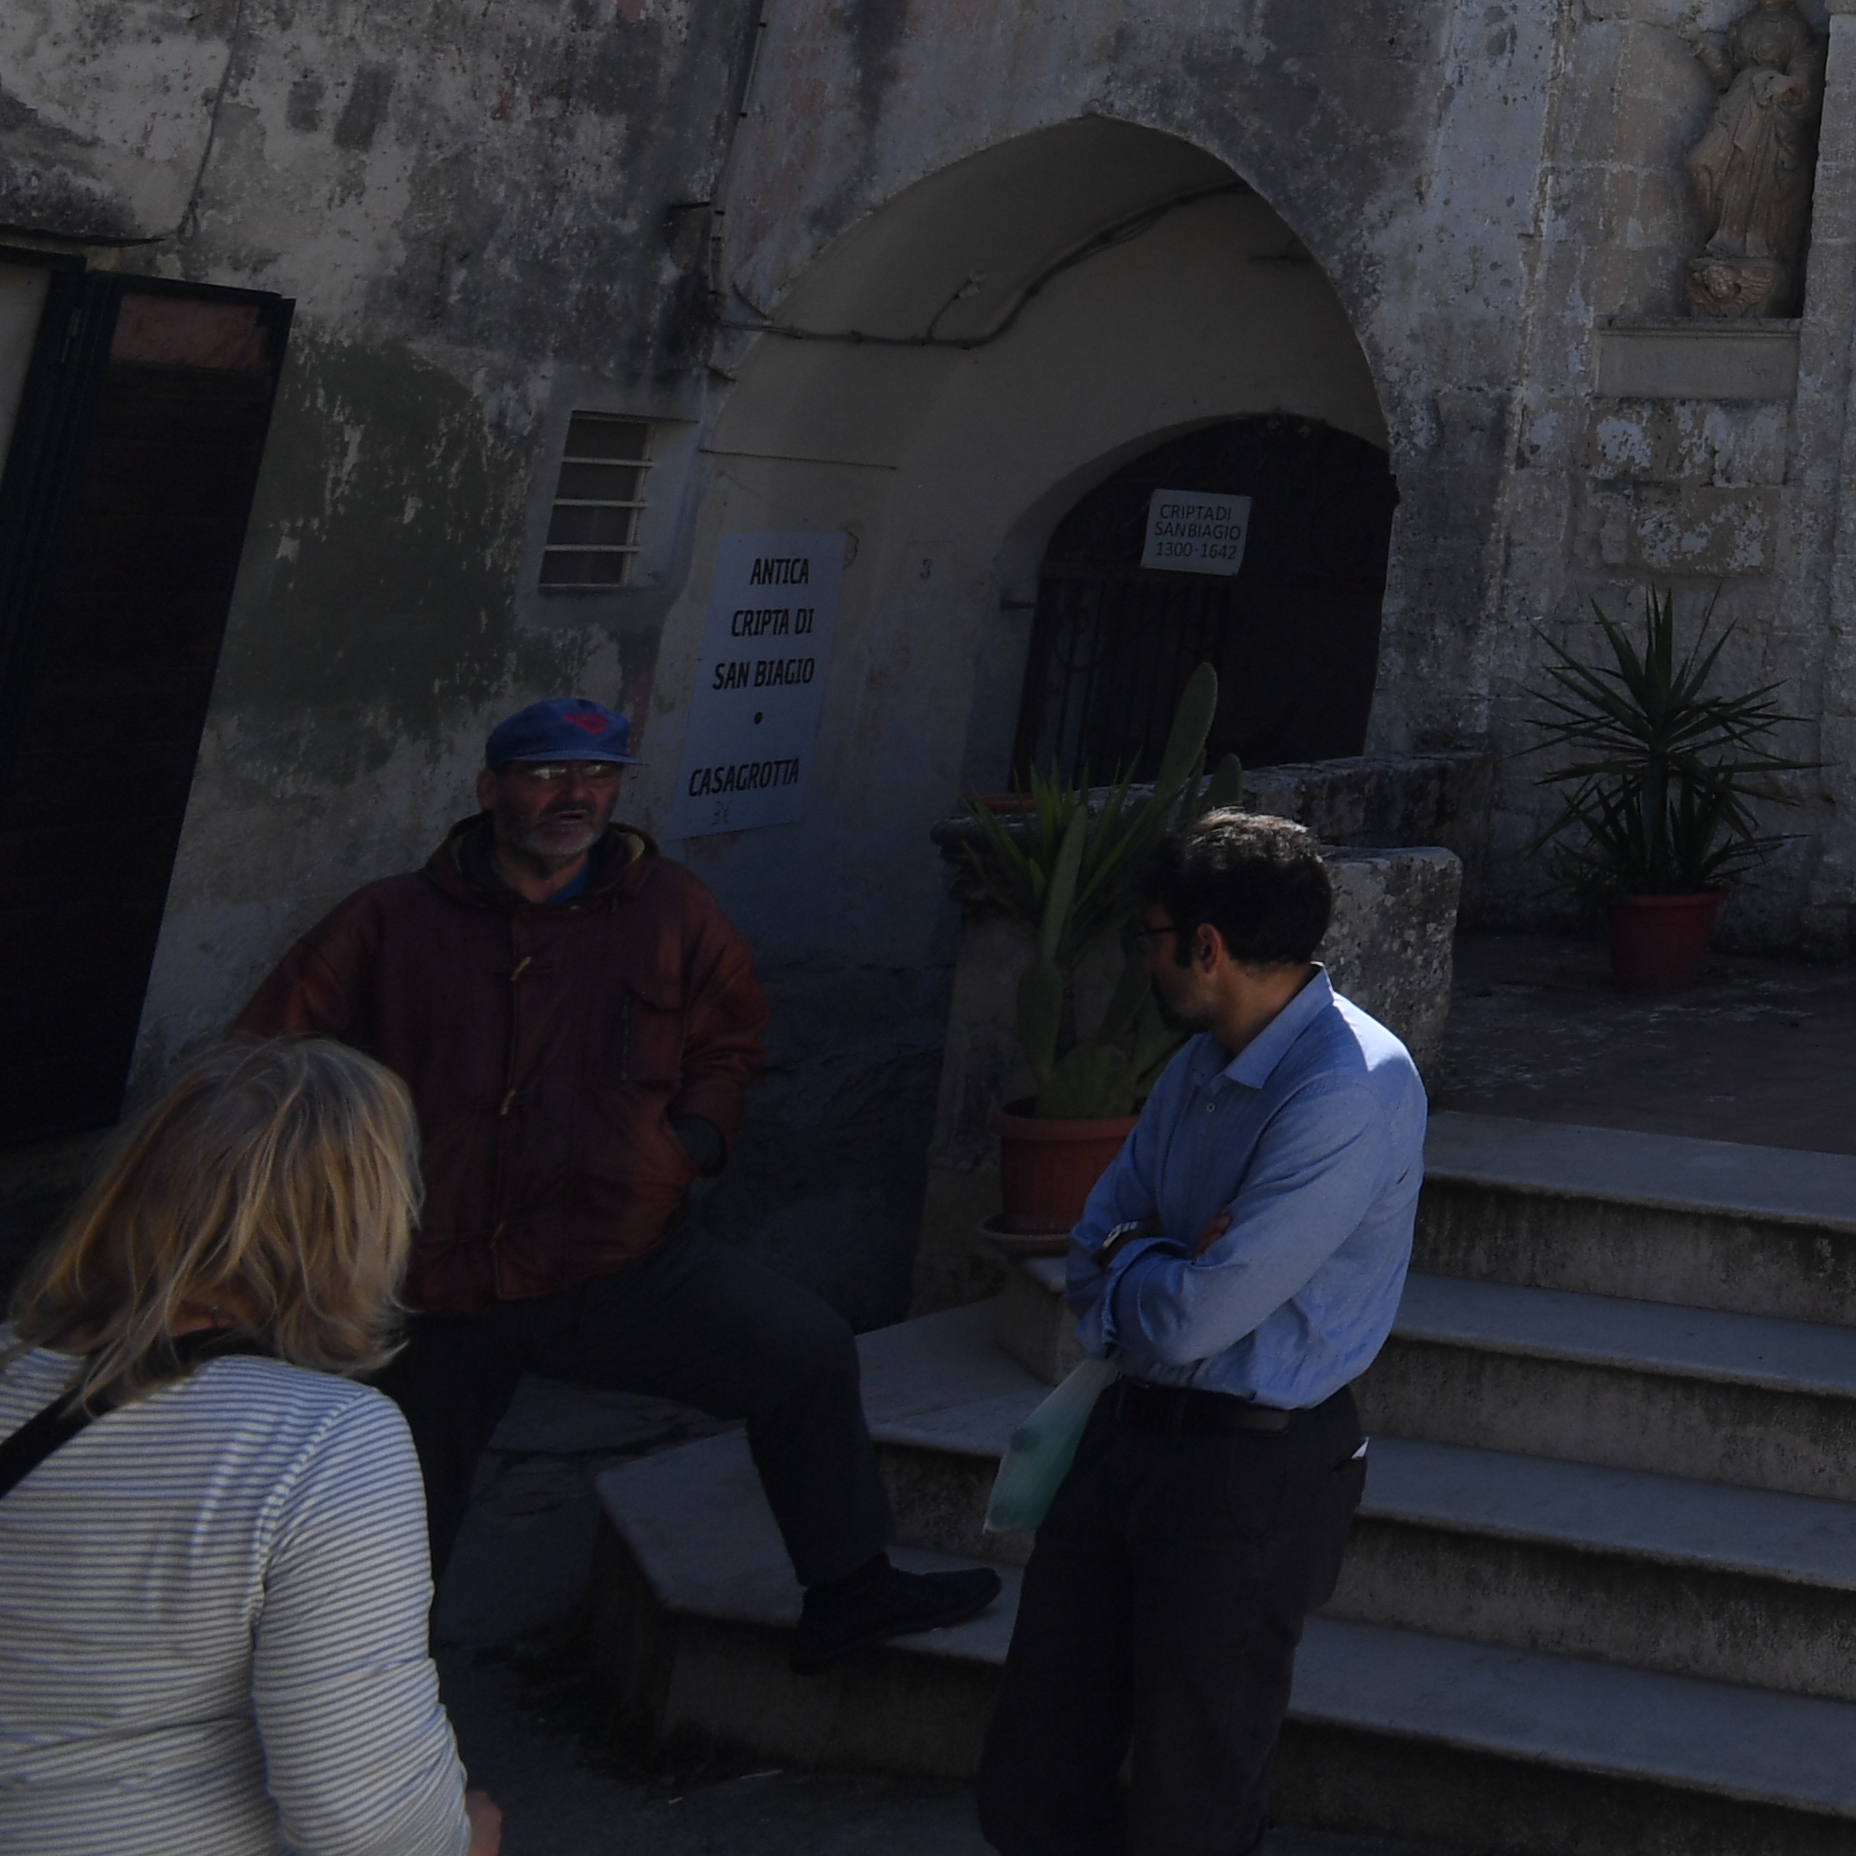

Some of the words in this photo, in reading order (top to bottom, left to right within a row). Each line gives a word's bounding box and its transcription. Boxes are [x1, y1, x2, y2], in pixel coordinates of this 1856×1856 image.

[750, 557, 809, 585] ANTICA
[920, 558, 933, 580] 3
[731, 609, 789, 637] CRIPTA
[795, 608, 815, 635] DI
[712, 661, 750, 690] SAN
[753, 658, 815, 687] BIAGIO
[688, 757, 800, 797] CASAGROTTA
